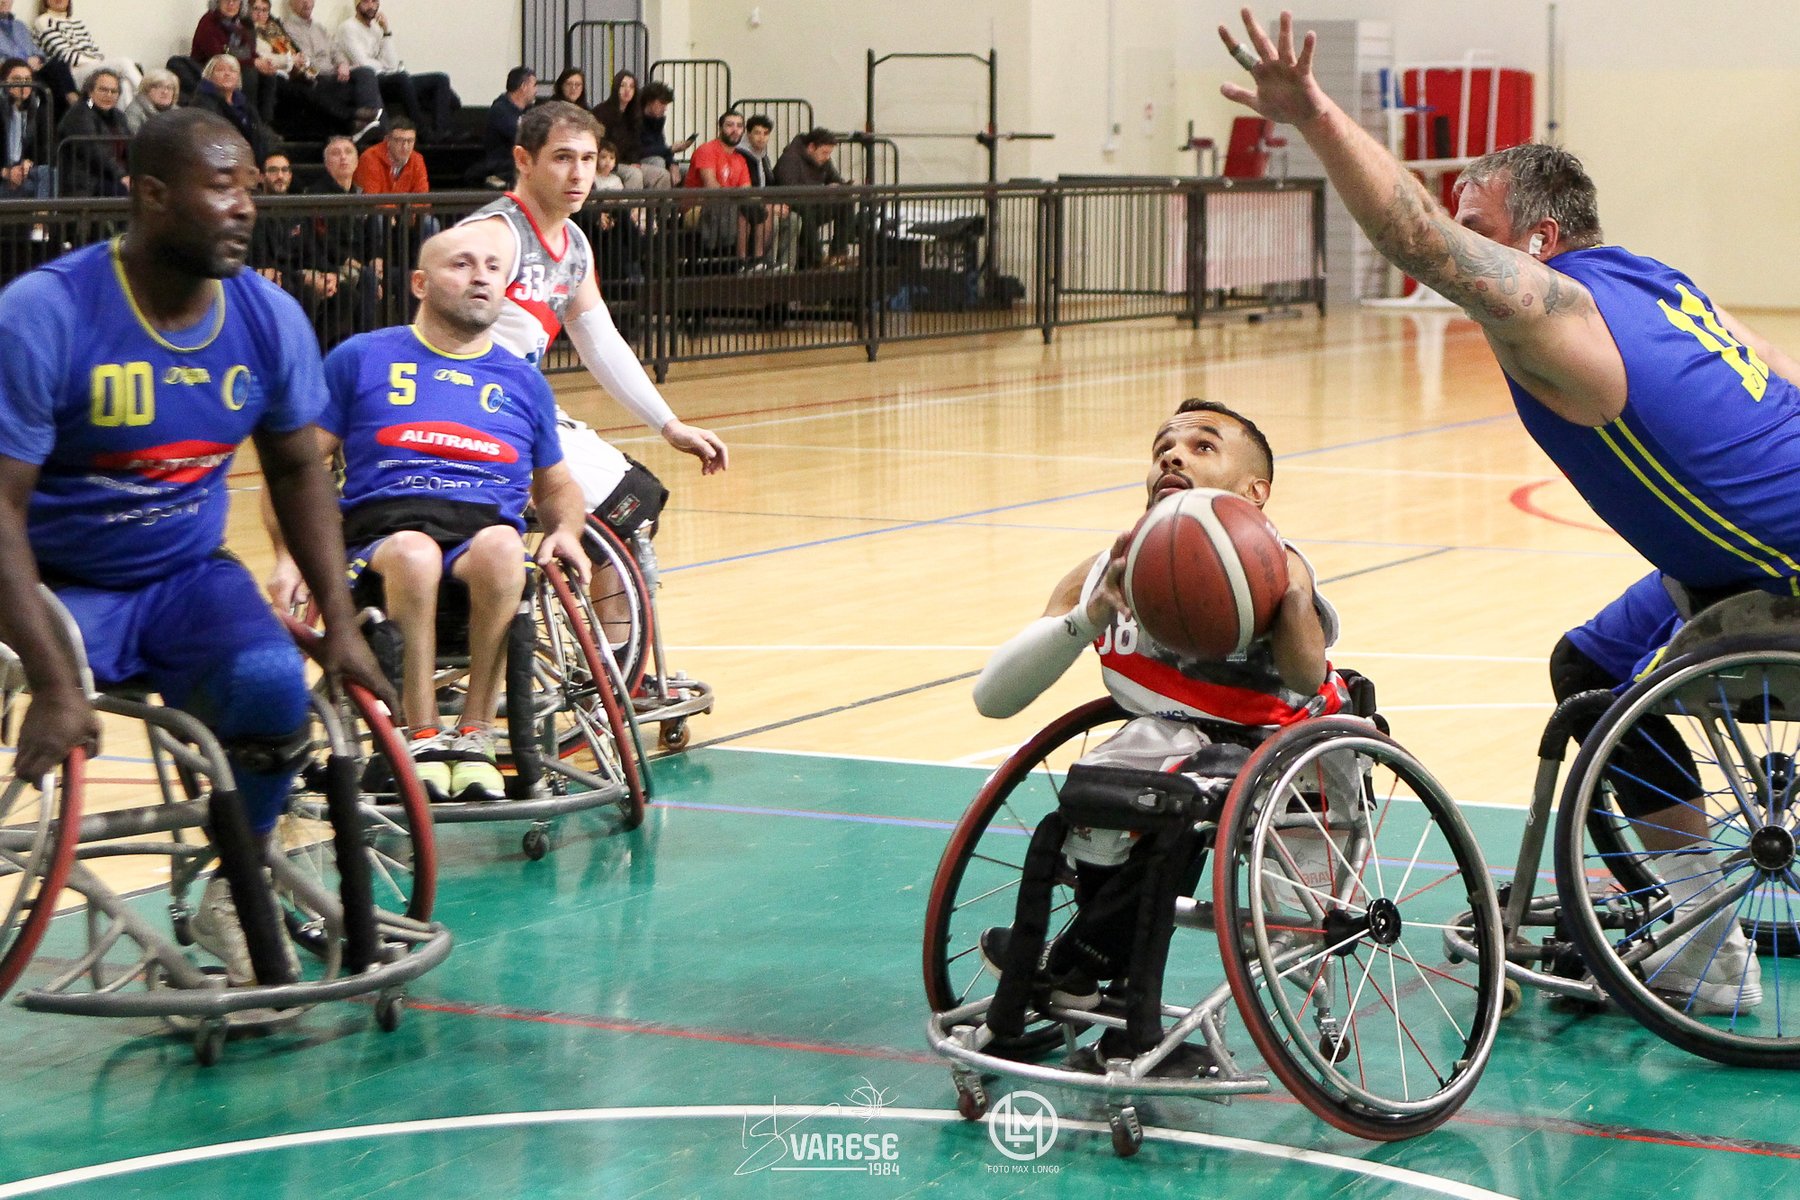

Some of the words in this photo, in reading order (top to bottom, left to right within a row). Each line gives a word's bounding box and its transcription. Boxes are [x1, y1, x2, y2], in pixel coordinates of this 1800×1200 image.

[514, 264, 545, 302] 33
[90, 361, 156, 427] 00
[387, 362, 418, 406] 5
[400, 429, 501, 456] ALITRANS
